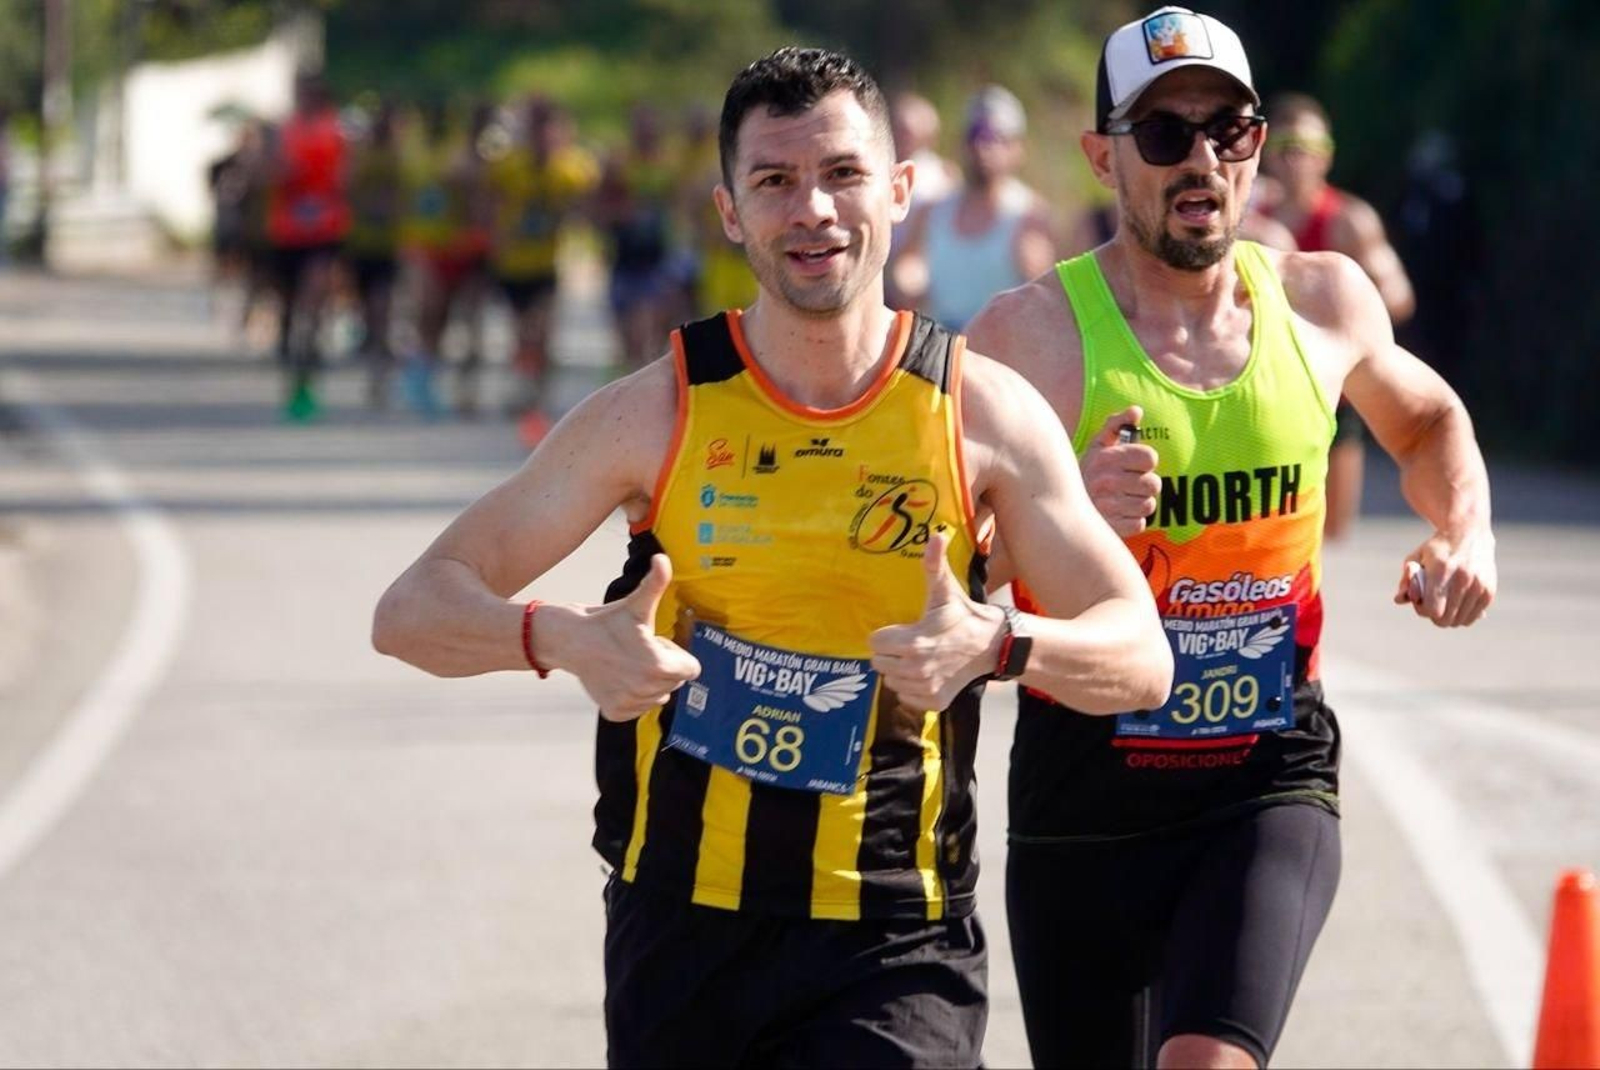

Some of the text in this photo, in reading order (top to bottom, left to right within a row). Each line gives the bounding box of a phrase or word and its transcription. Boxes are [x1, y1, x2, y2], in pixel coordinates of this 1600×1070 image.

[855, 484, 874, 498] do
[1146, 463, 1302, 528] NORTH
[1169, 571, 1293, 604] Gasóleos
[722, 637, 754, 658] MEDIO
[754, 648, 803, 671] MARATÓN
[803, 658, 831, 673] GRAN
[752, 704, 802, 723] ADRIAN
[1171, 675, 1260, 725] 309
[735, 717, 805, 773] 68
